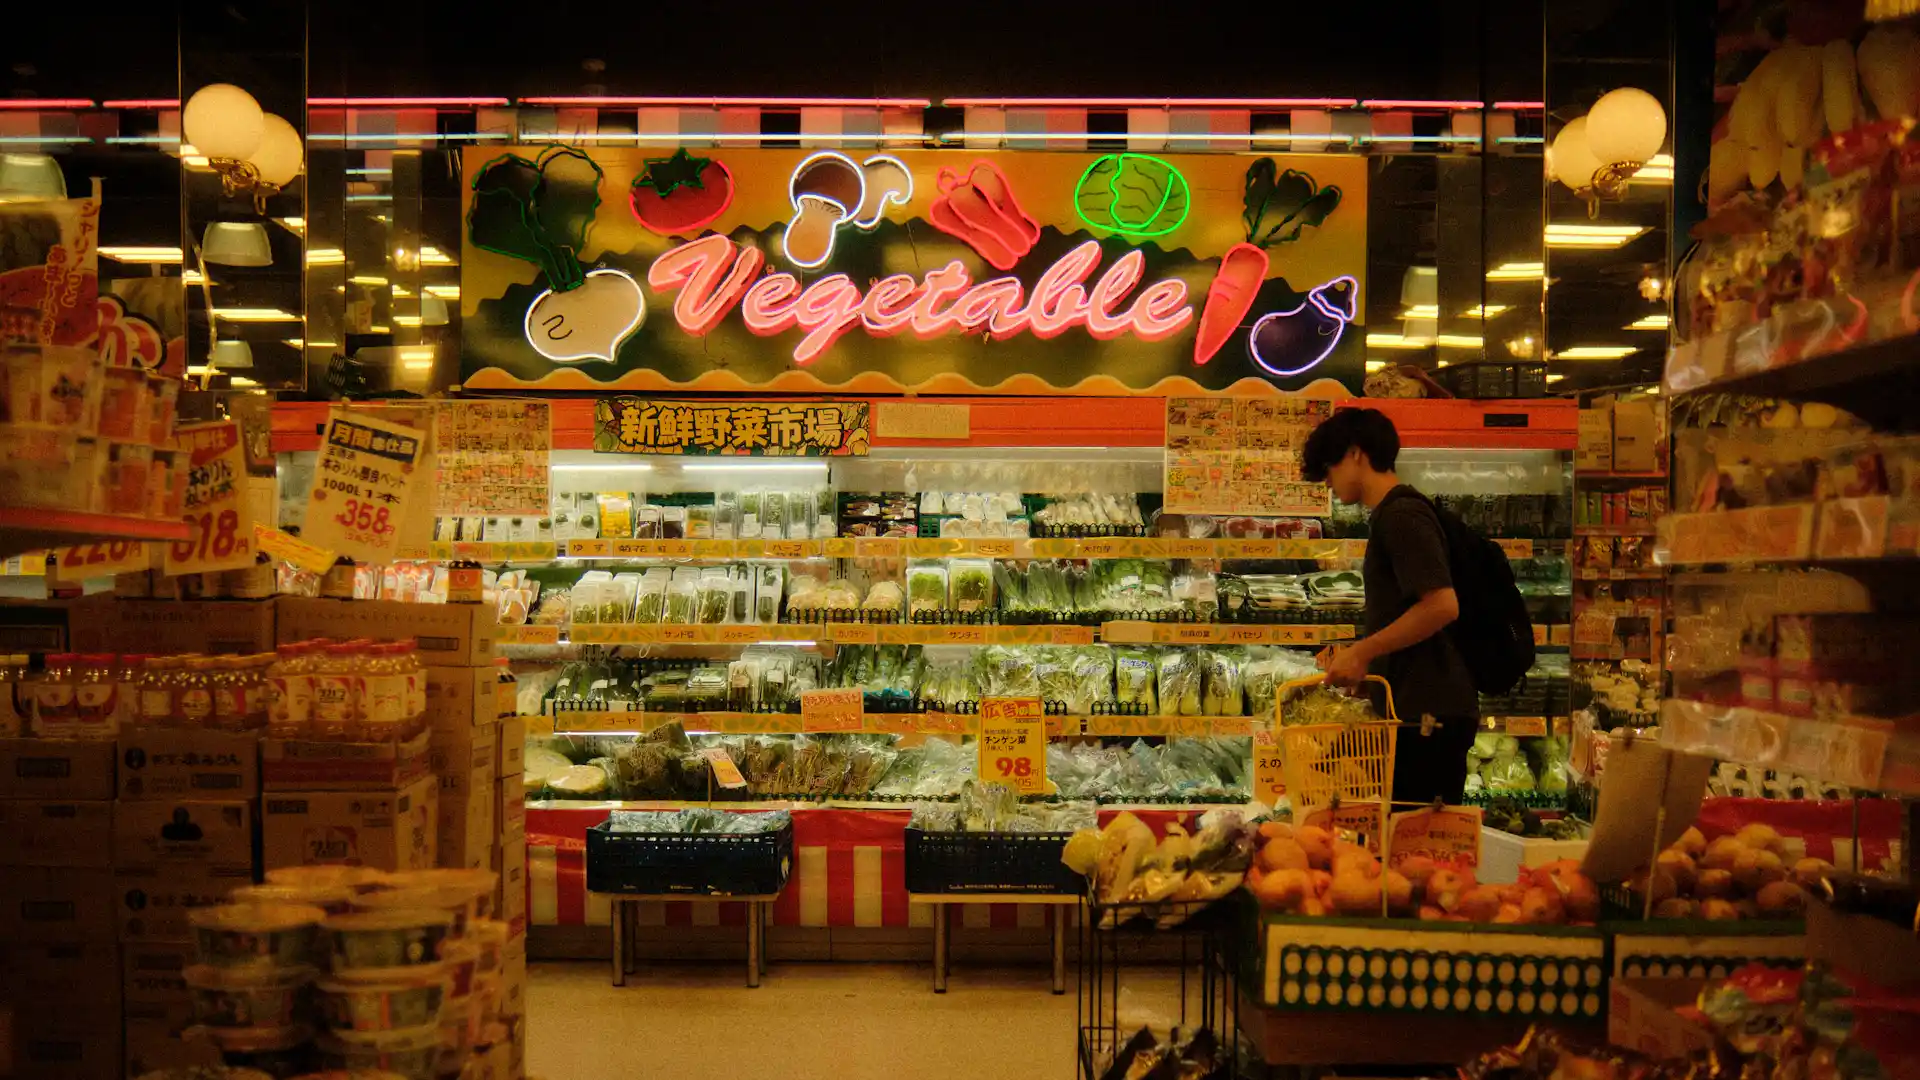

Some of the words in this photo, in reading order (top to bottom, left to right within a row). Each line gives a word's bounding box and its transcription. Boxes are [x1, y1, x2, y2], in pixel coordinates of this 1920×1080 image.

[648, 233, 1194, 365] Vegetable
[619, 404, 846, 450] 新鮮野菜市場
